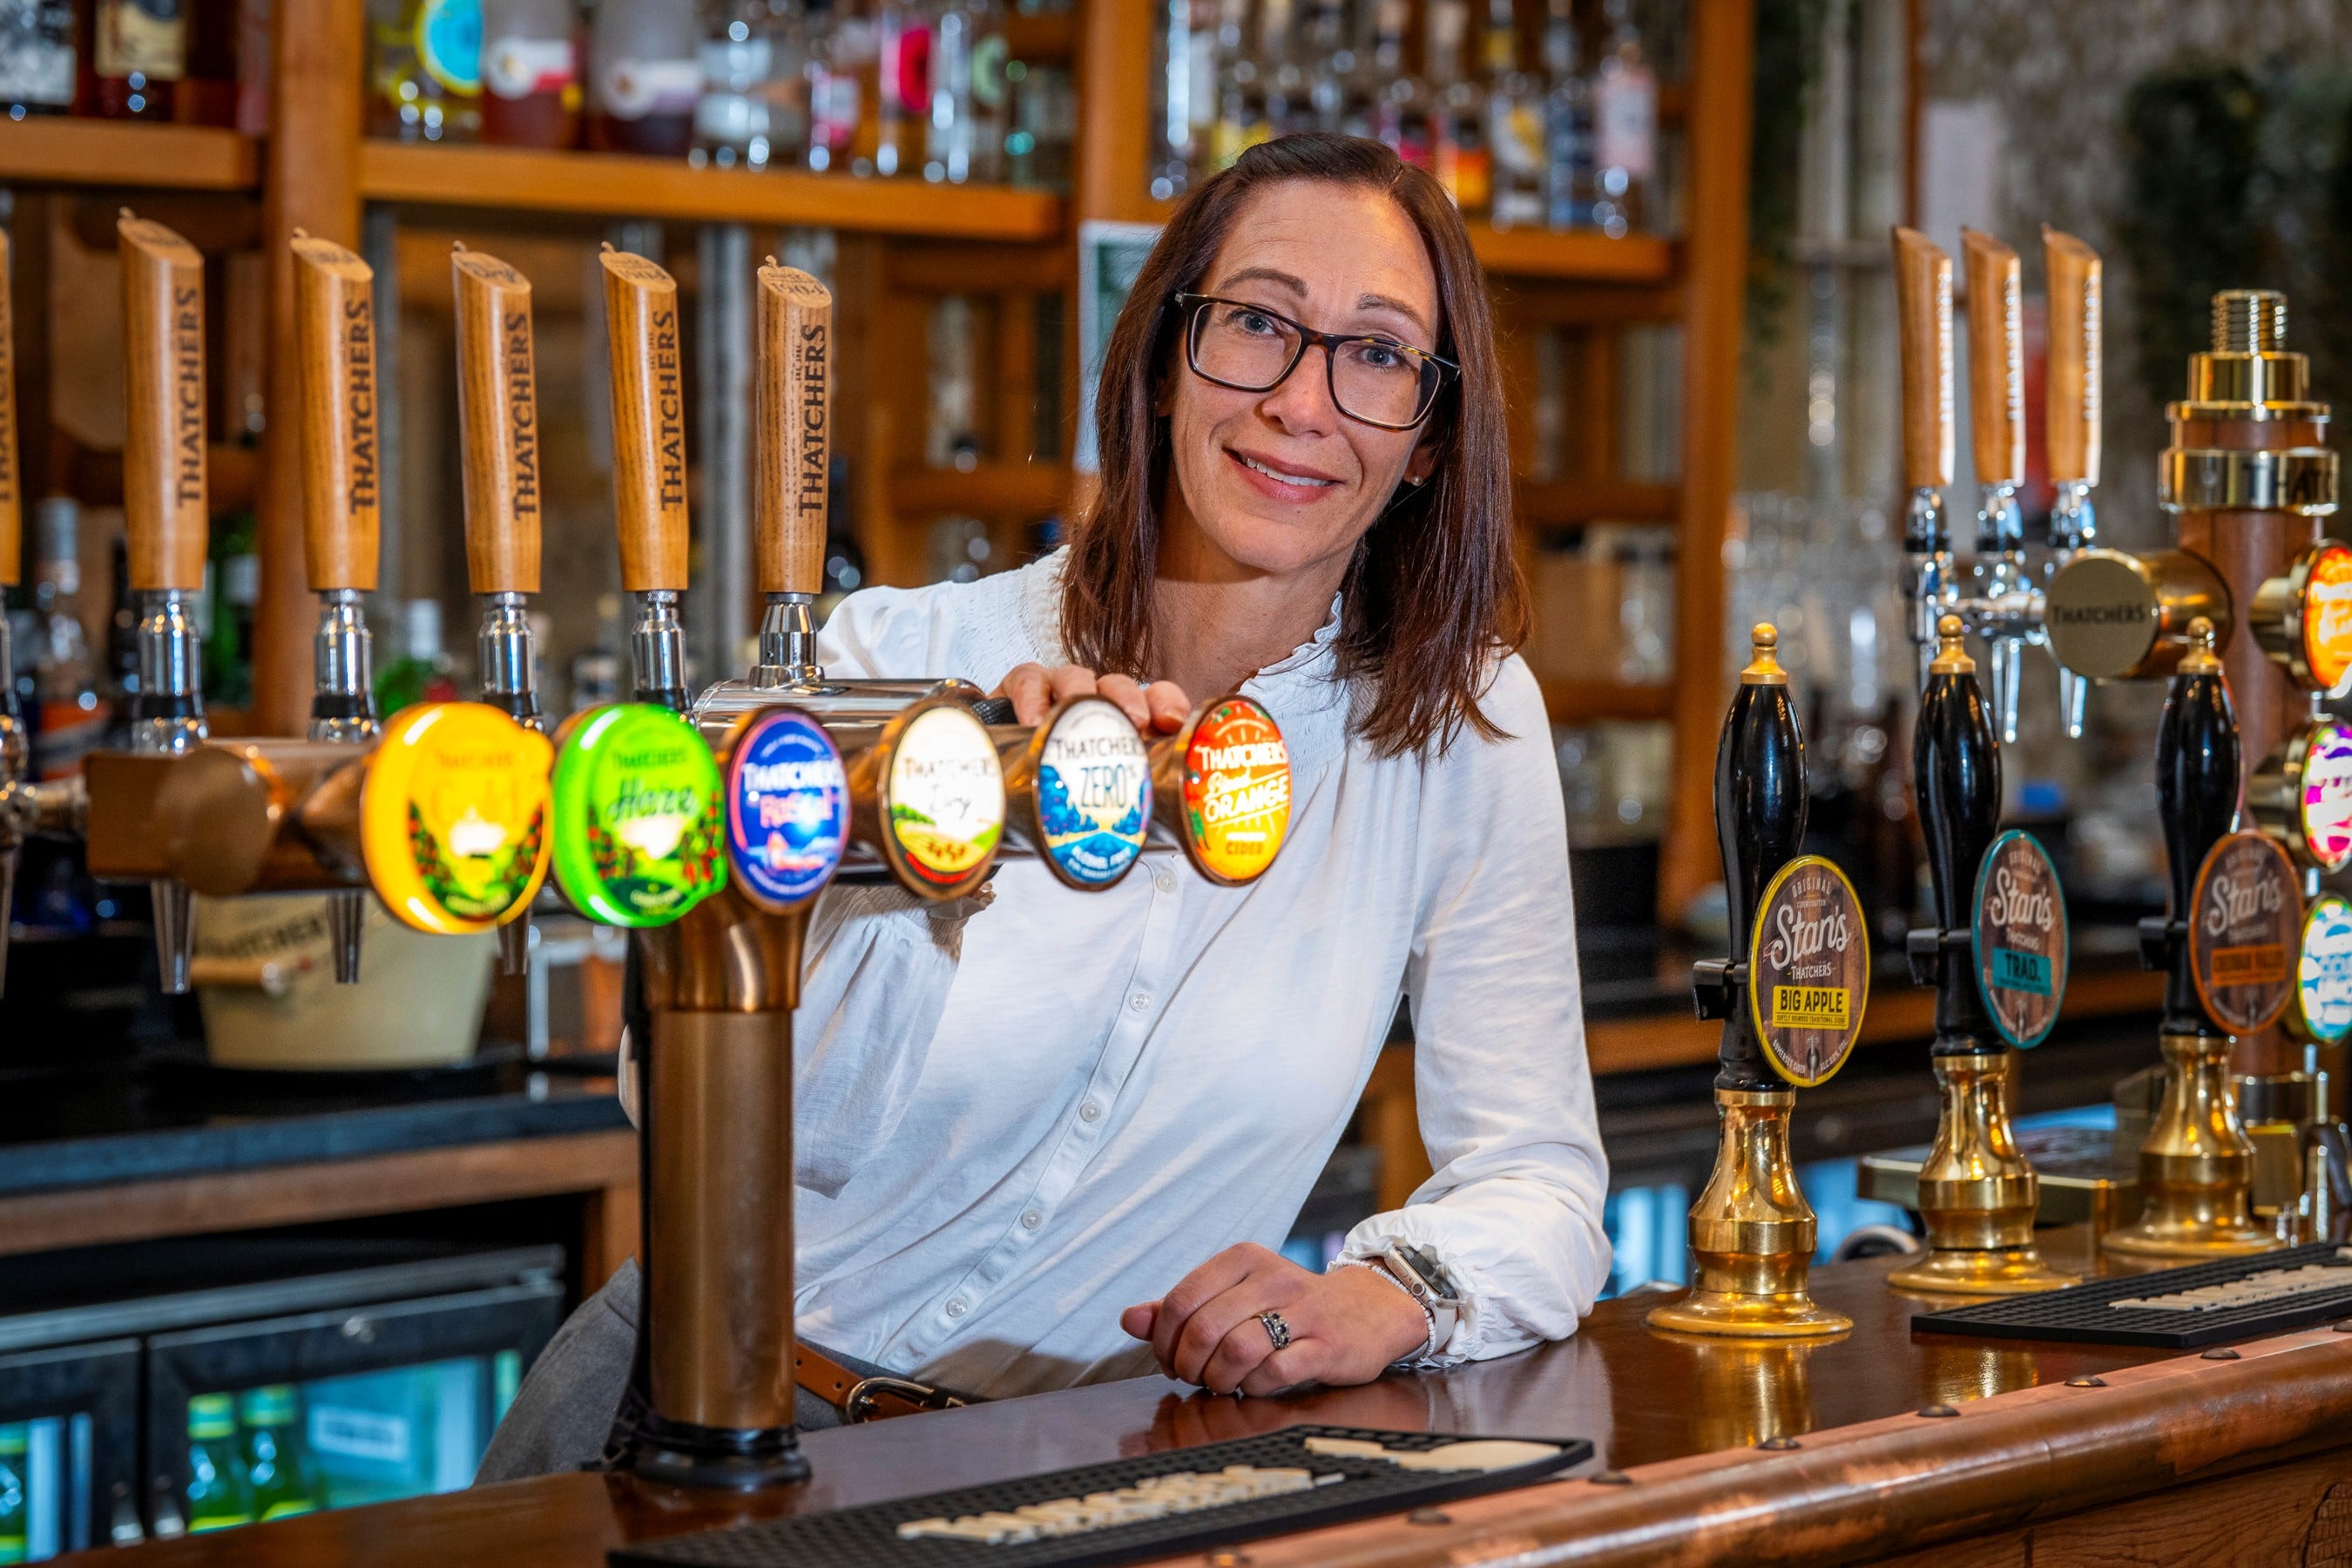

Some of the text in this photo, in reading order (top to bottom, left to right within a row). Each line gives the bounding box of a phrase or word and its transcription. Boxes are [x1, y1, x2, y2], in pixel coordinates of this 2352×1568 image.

[175, 286, 201, 508] THATCHERS
[345, 300, 375, 516] THATCHERS
[504, 311, 537, 521] THATCHERS
[653, 309, 683, 511] THATCHERS
[798, 324, 827, 517] THATCHERS
[607, 778, 700, 823] Haze
[1079, 763, 1127, 809] ZERO
[1204, 774, 1289, 823] ORANGE
[1792, 877, 1832, 899] ORIGINAL
[1990, 866, 2055, 933] Stan's
[2207, 874, 2284, 937] Stan's
[1770, 904, 1851, 971] Stan's
[1780, 989, 1843, 1013] BIG APPLE
[1790, 963, 1832, 981] THATCHERS
